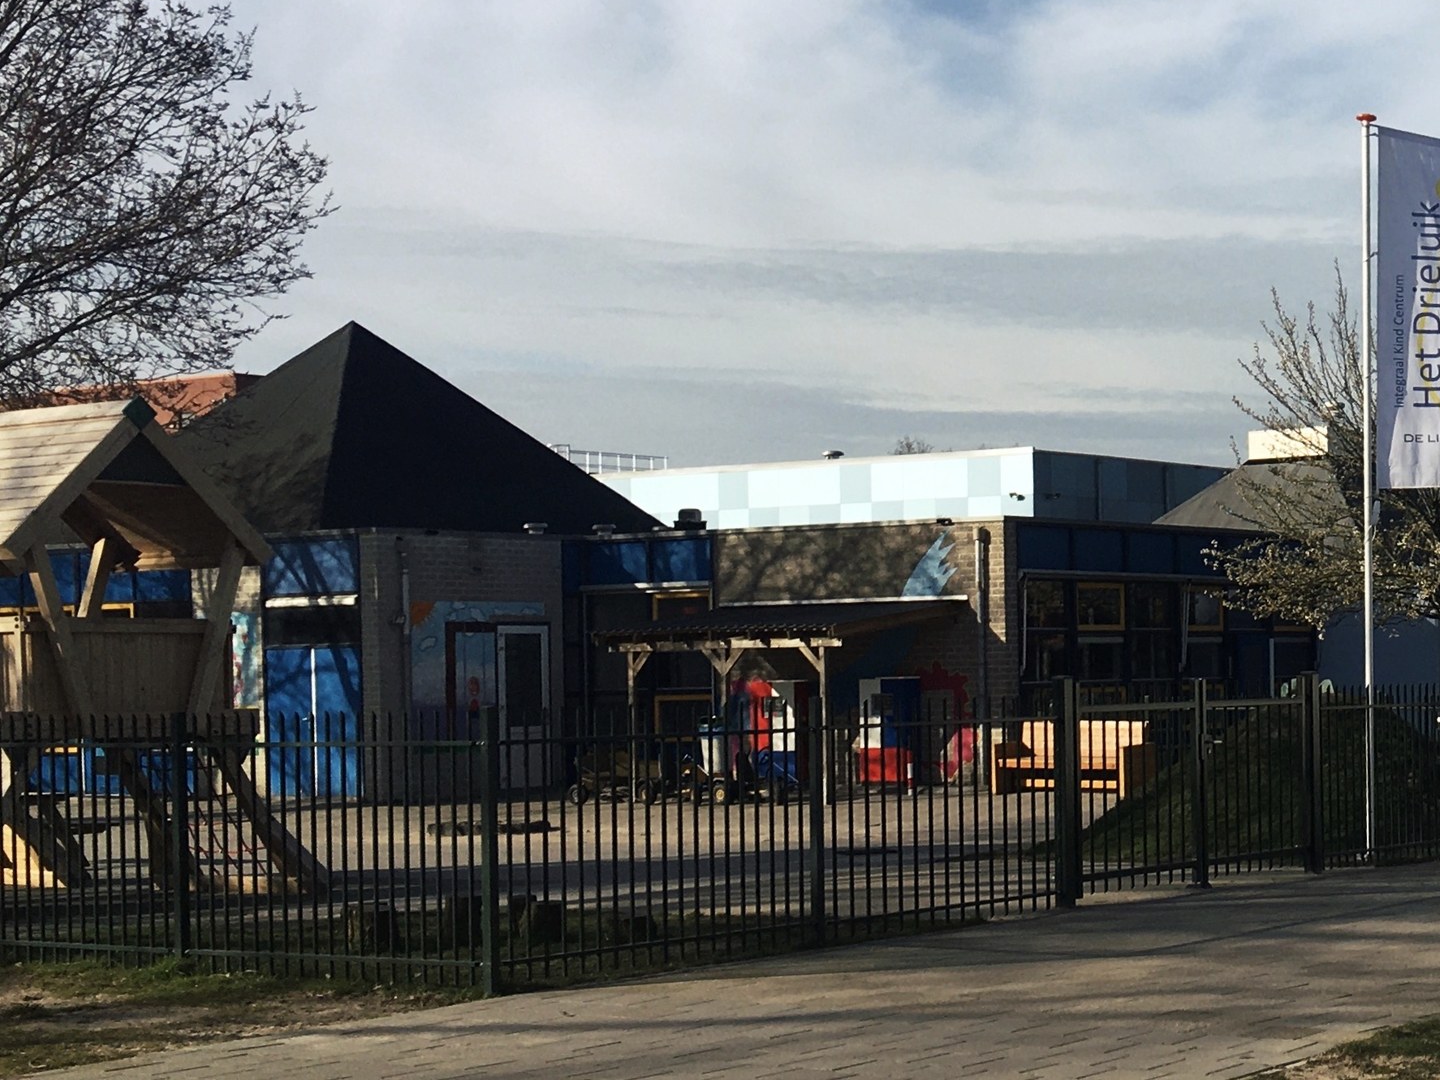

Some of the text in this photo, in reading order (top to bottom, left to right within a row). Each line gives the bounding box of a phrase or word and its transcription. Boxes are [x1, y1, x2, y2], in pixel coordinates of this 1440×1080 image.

[1393, 274, 1407, 408] Integraal Kind Centrum
[1403, 434, 1424, 443] DE
